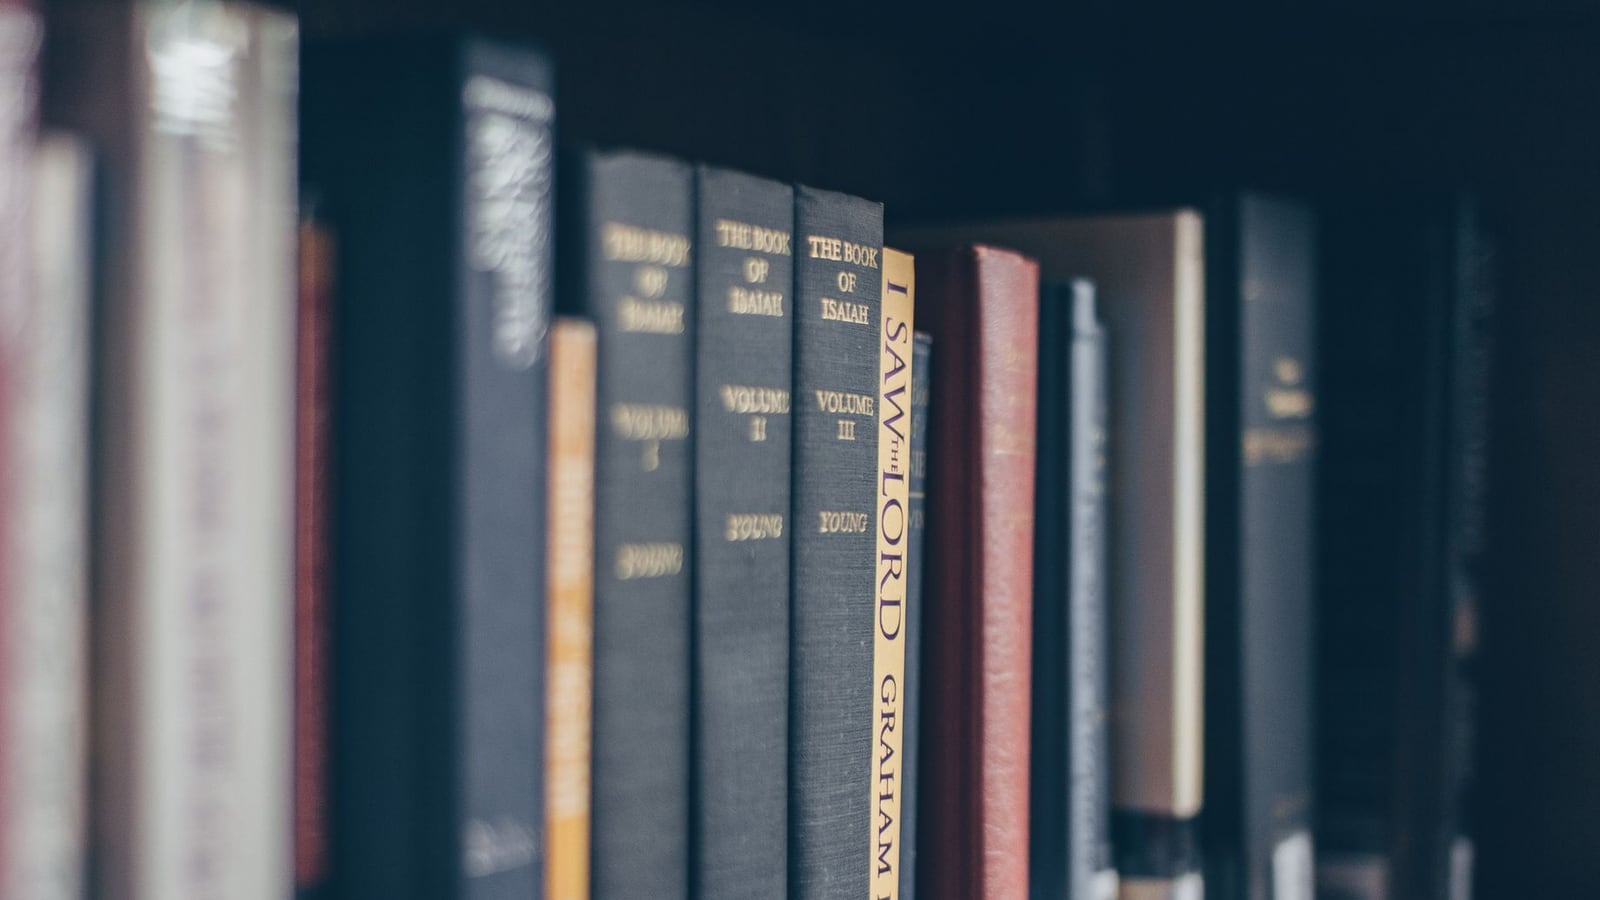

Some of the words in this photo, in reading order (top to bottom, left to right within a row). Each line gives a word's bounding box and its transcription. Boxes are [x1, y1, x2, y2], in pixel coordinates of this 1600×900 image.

[717, 219, 752, 249] THE
[753, 225, 791, 255] BOOK
[807, 235, 842, 261] THE
[844, 242, 879, 269] BOOK
[744, 256, 769, 283] OF
[837, 271, 857, 293] OF
[729, 285, 784, 317] ISAIAH
[887, 279, 908, 297] I
[820, 297, 869, 325] ISAIAH
[883, 316, 908, 442] SAW
[816, 390, 874, 416] VOLUME
[751, 415, 767, 442] II
[837, 419, 856, 441] III
[891, 437, 899, 472] THE
[726, 512, 783, 541] YOUNG
[819, 511, 868, 534] YOUNG
[880, 470, 904, 641] LORD
[877, 674, 897, 879] GRAHAM
